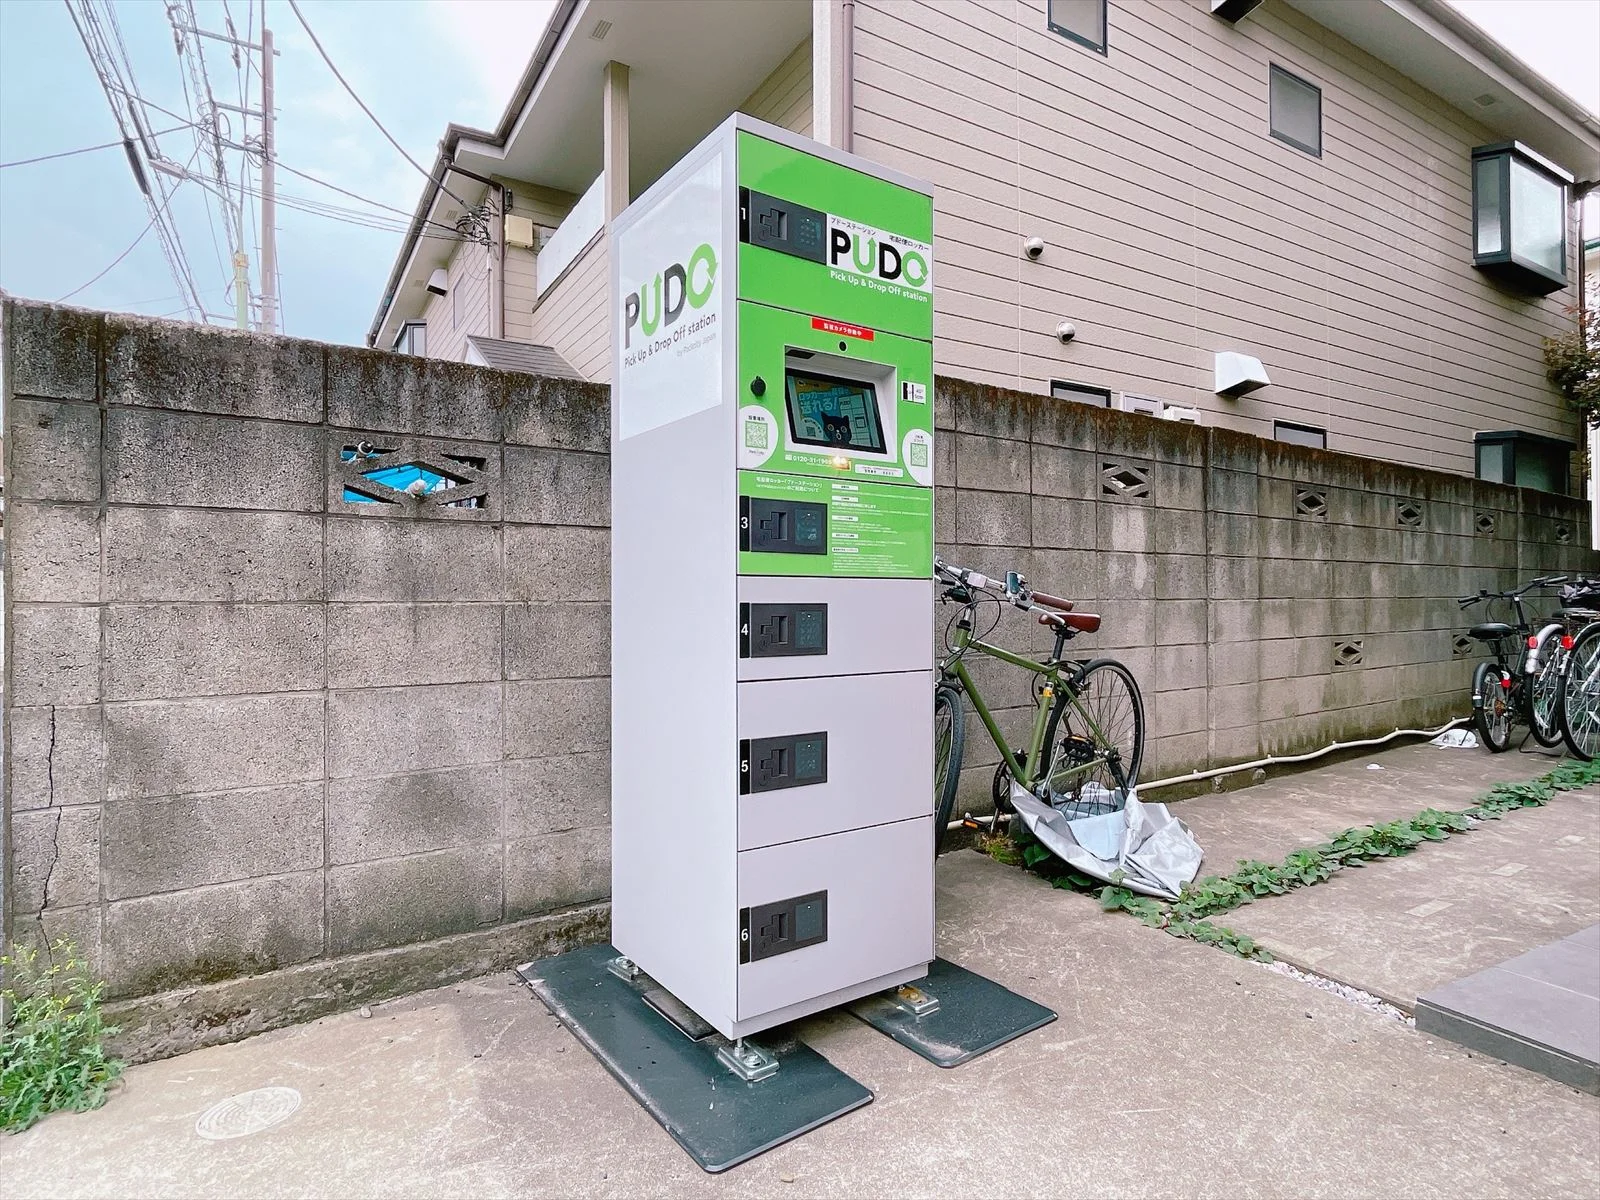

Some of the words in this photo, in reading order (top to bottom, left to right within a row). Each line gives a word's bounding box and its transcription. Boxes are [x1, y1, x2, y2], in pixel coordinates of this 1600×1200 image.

[740, 207, 746, 220] 1
[889, 235, 929, 251] 宅配便ロッカー
[831, 228, 929, 288] PUDO
[830, 271, 846, 281] Pick
[848, 275, 859, 287] Up
[861, 279, 867, 287] &
[868, 281, 887, 293] Drop
[888, 286, 901, 296] Off
[903, 290, 928, 303] station
[625, 243, 718, 350] PUDO
[624, 354, 637, 368] Pick
[637, 350, 647, 363] Up
[648, 345, 653, 356] &
[655, 337, 672, 352] Drop
[673, 325, 686, 343] Off
[688, 313, 716, 336] station
[740, 516, 749, 529] 3
[740, 623, 749, 636] 4
[741, 760, 749, 773] 5
[741, 928, 749, 941] 6
